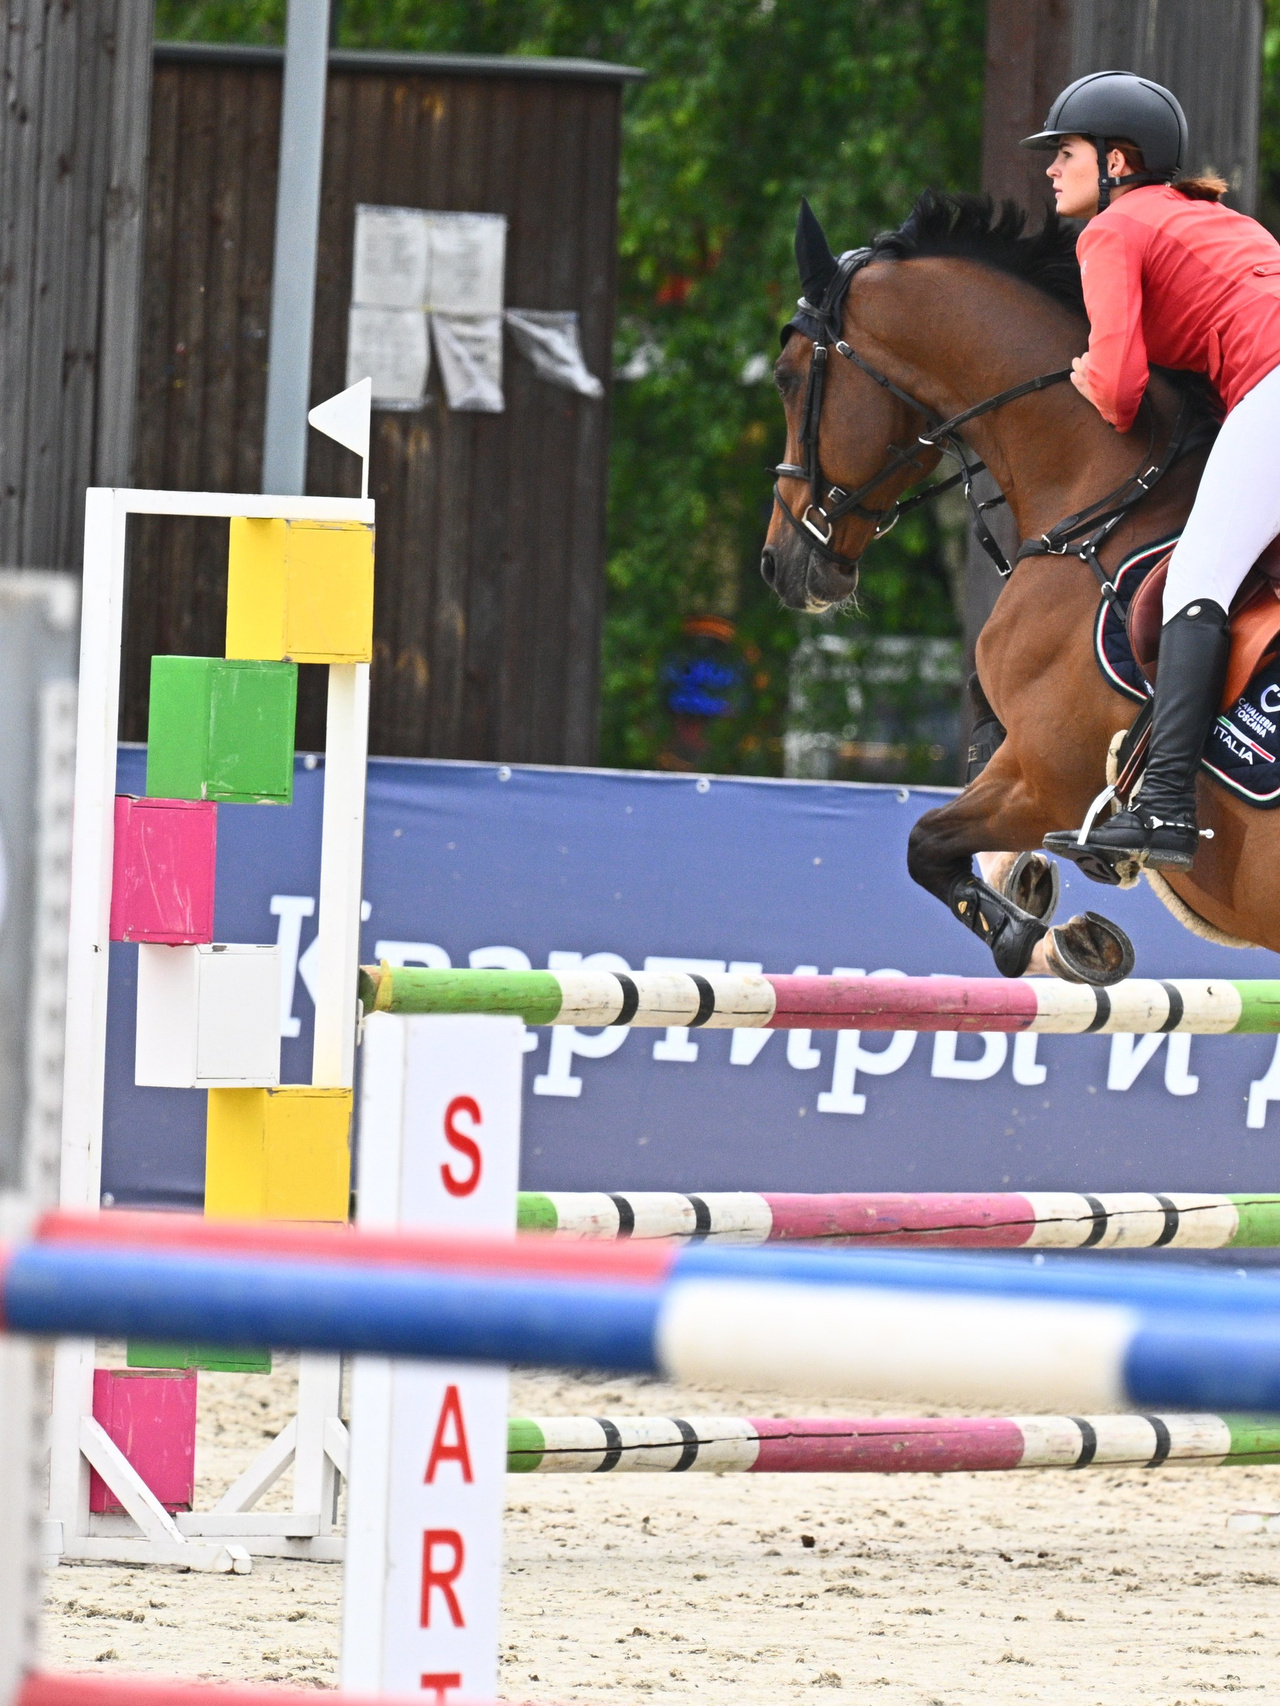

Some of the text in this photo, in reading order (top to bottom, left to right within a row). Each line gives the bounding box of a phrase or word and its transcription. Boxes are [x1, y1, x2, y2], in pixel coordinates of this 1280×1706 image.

[1234, 706, 1268, 738] TOSCANA
[1238, 697, 1277, 734] CAVALLERIA
[1213, 725, 1254, 765] ITALIA
[418, 1095, 483, 1706] SAR
